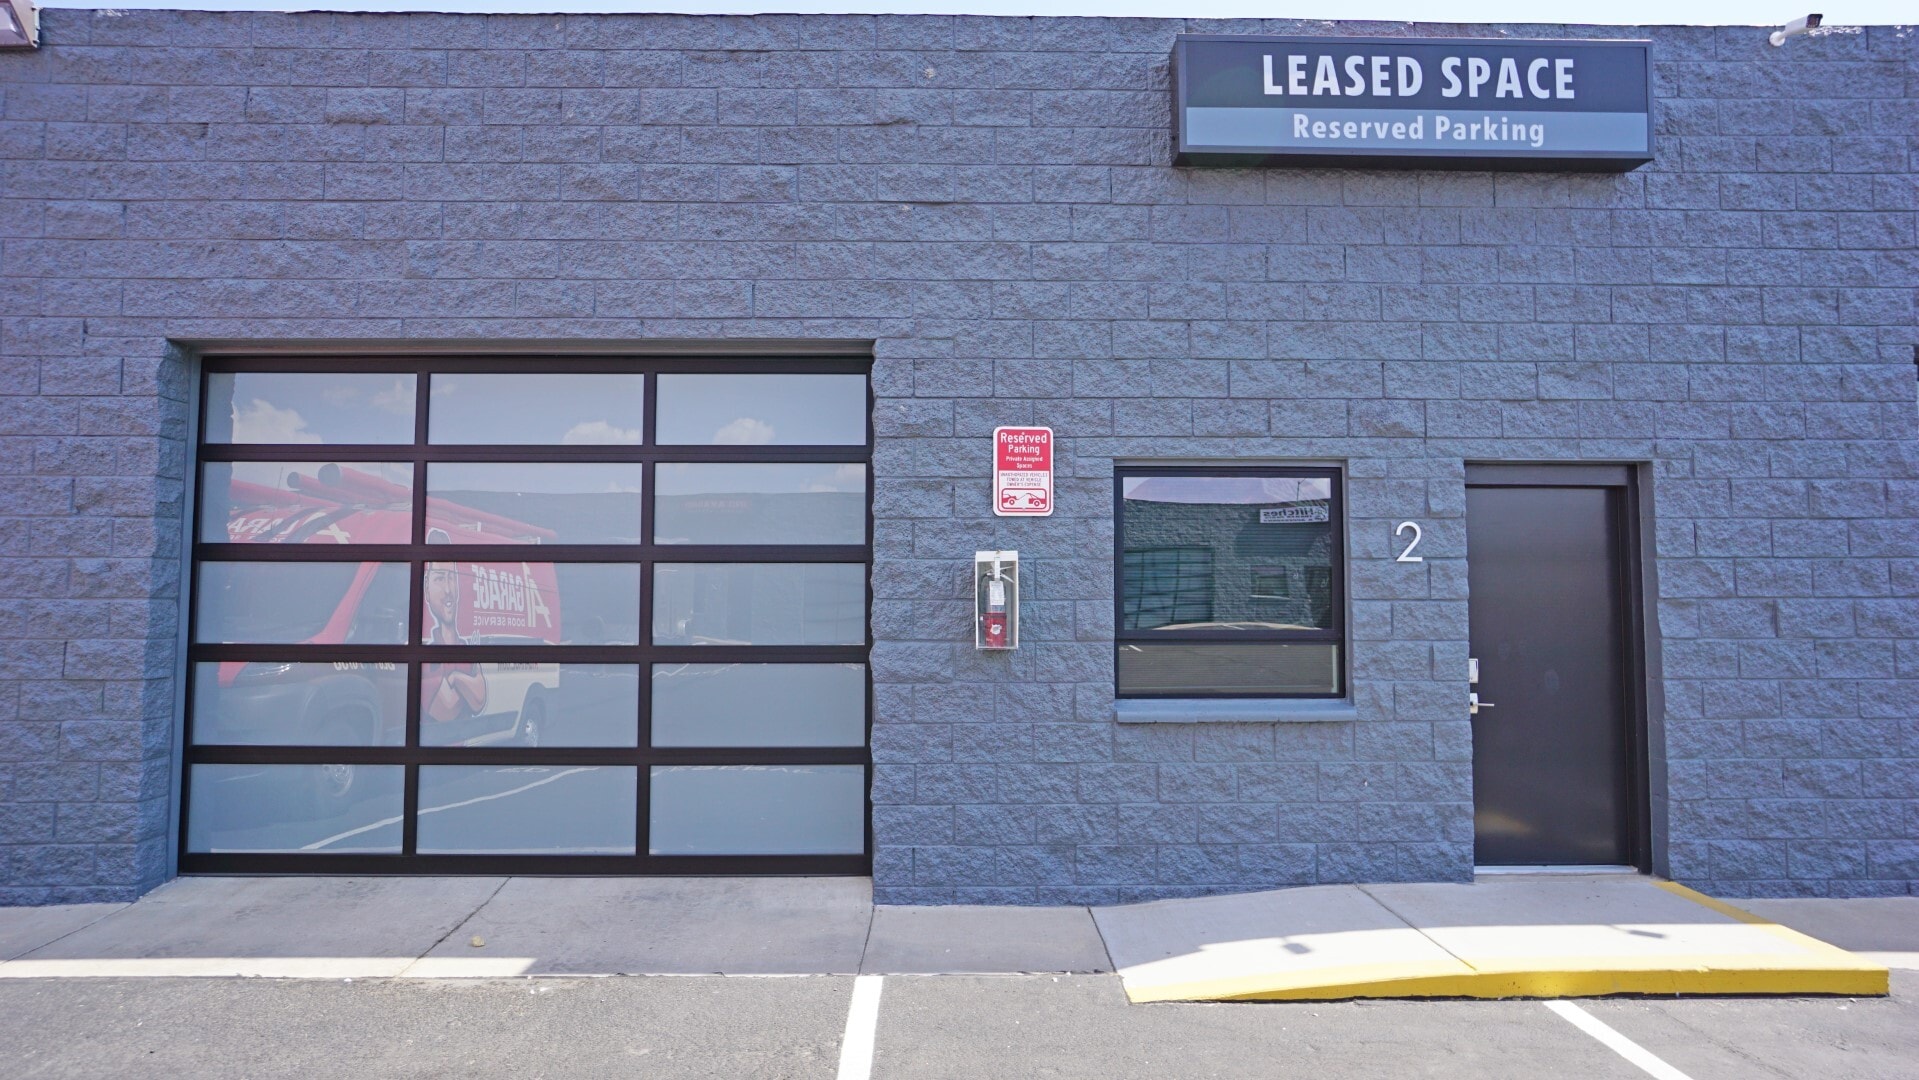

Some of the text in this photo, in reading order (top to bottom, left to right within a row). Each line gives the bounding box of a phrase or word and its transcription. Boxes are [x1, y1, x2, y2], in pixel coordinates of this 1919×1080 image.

[1262, 55, 1575, 99] LEASED SPACE
[1293, 114, 1545, 147] Reserved Parking
[1000, 432, 1047, 443] Reserved
[1008, 444, 1040, 455] Parking
[1395, 521, 1423, 562] 2
